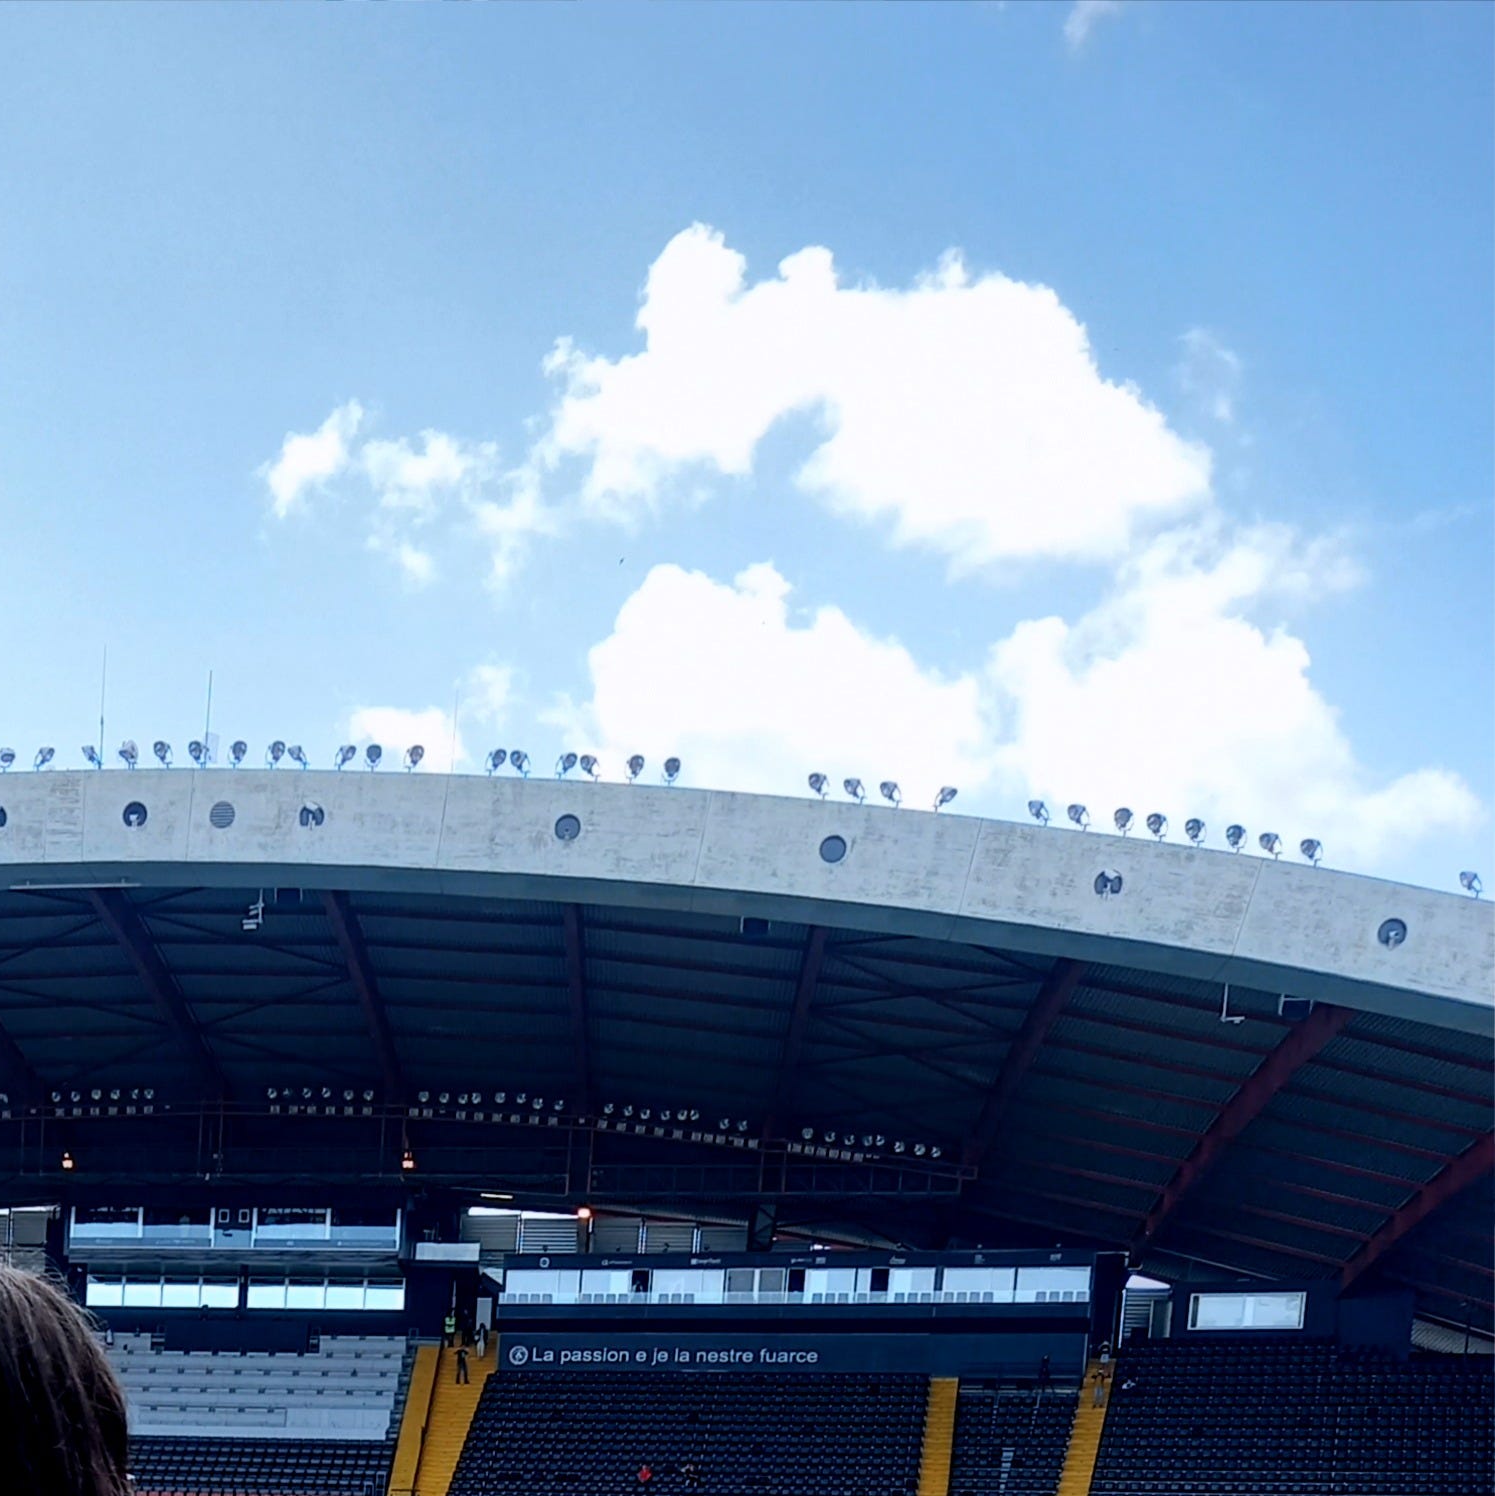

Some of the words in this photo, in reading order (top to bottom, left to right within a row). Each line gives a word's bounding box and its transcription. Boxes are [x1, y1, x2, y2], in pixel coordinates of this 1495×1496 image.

[532, 1347, 554, 1362] La
[560, 1347, 630, 1365] passion
[635, 1350, 647, 1362] e
[651, 1347, 669, 1366] je
[674, 1347, 690, 1363] la
[695, 1348, 754, 1363] nestre
[759, 1348, 818, 1363] fuarce
